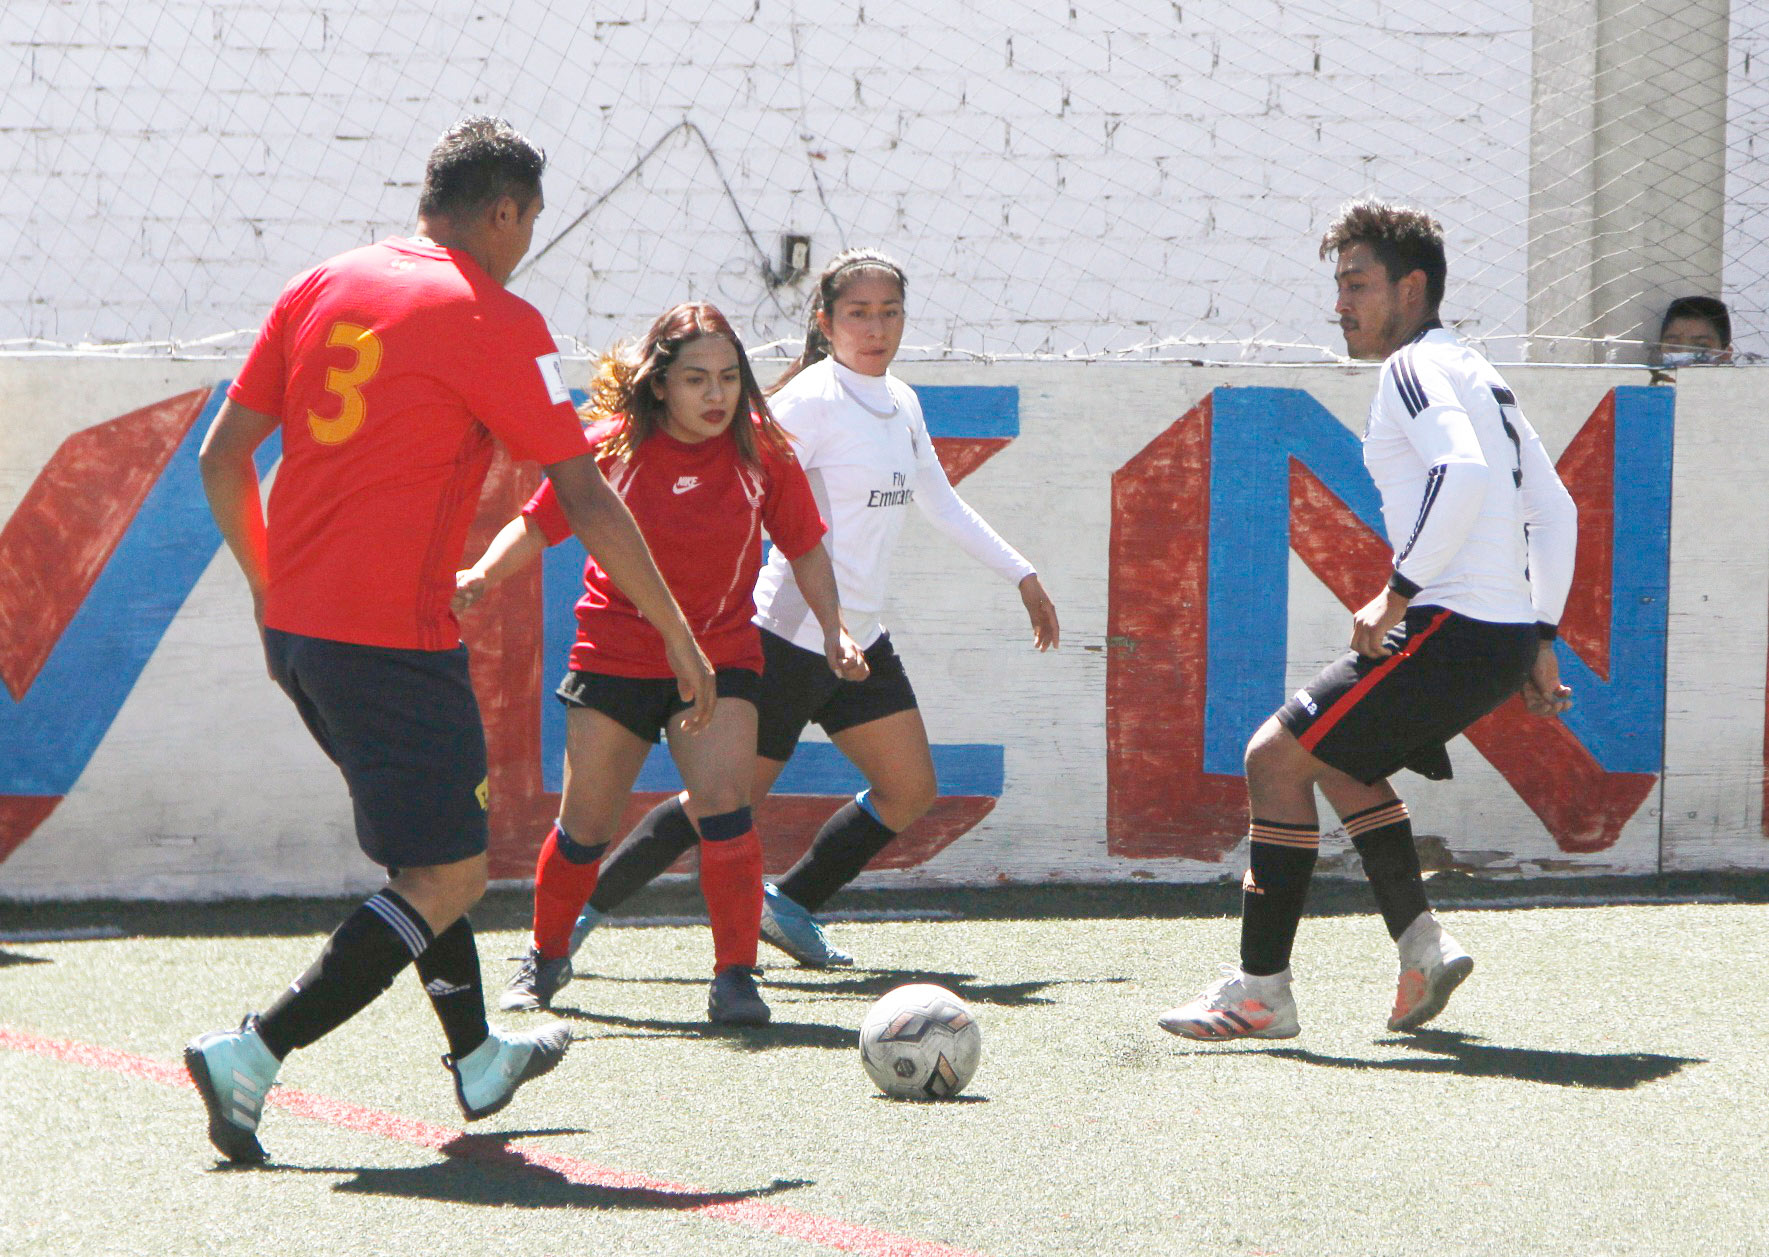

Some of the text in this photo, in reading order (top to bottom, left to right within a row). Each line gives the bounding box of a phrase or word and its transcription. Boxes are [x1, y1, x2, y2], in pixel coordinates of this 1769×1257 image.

[307, 321, 383, 445] 3
[677, 475, 699, 487] NIKE
[893, 471, 906, 487] Fly
